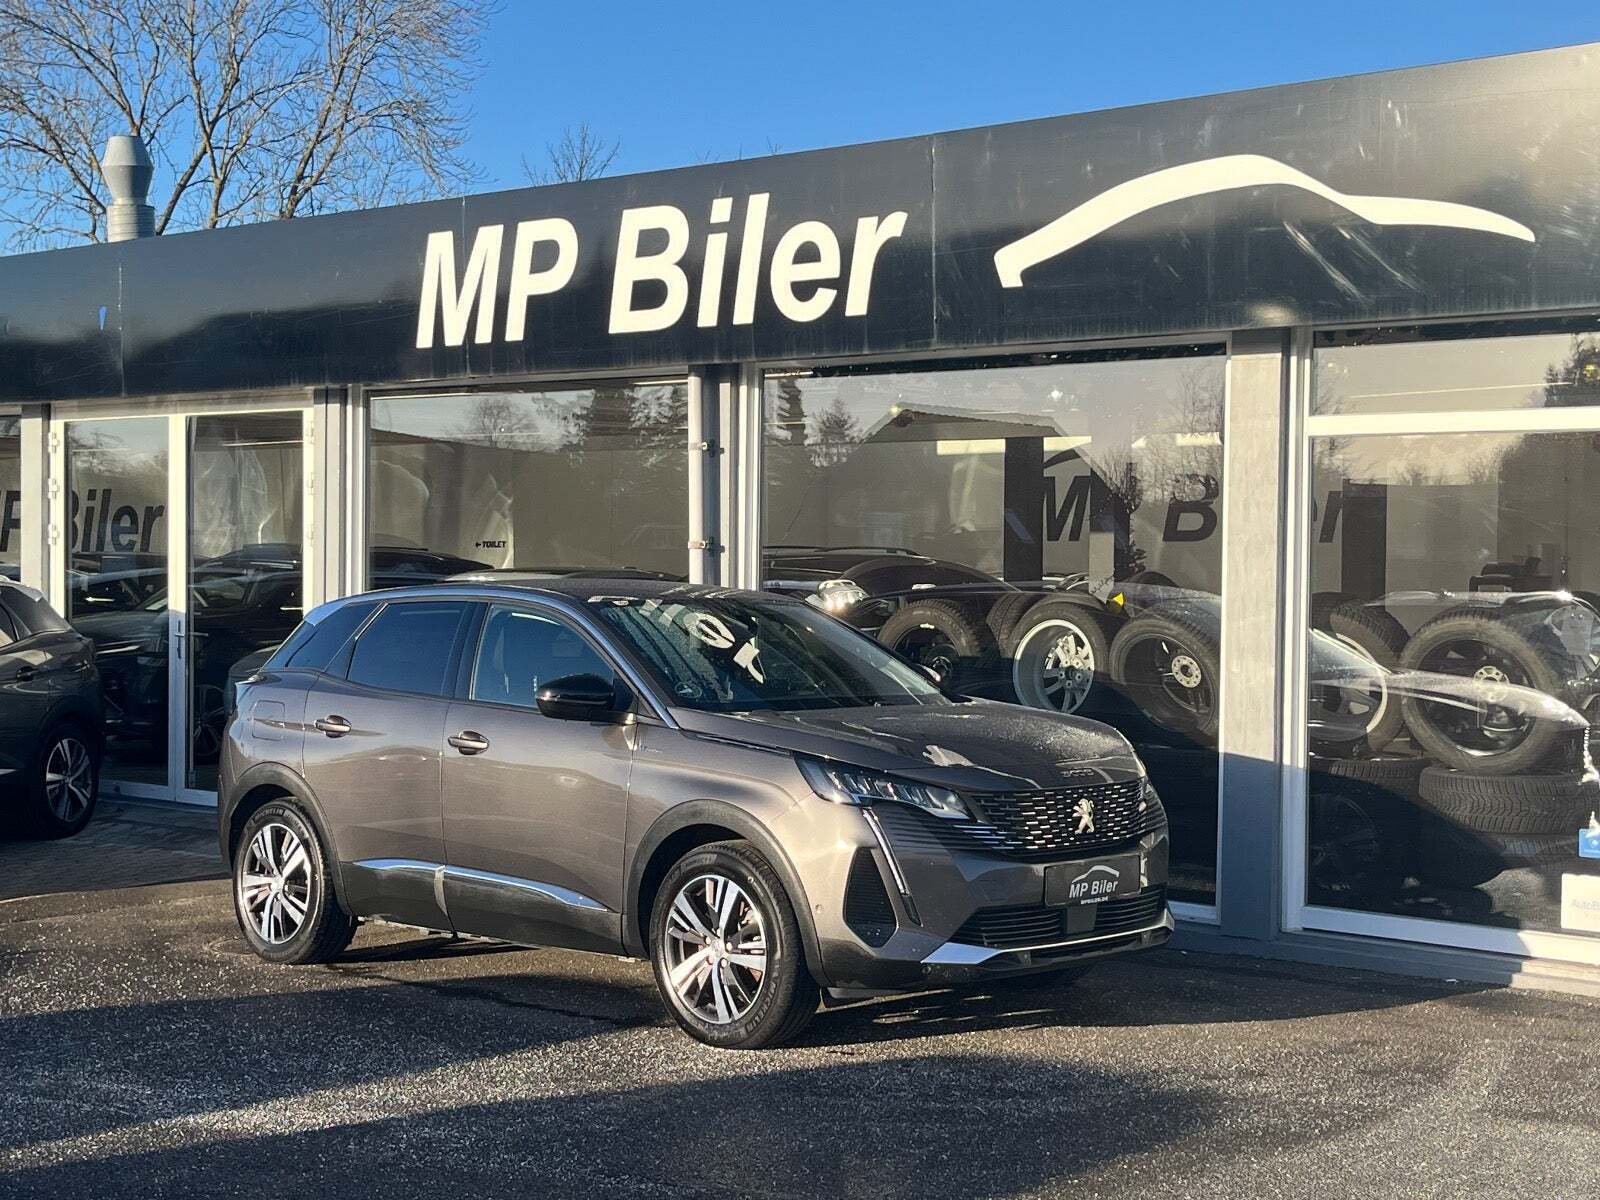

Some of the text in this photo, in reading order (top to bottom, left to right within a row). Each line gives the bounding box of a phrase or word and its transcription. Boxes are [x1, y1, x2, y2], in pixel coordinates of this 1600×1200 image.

[416, 192, 908, 349] MP Biler
[1069, 879, 1119, 899] MP Biler
